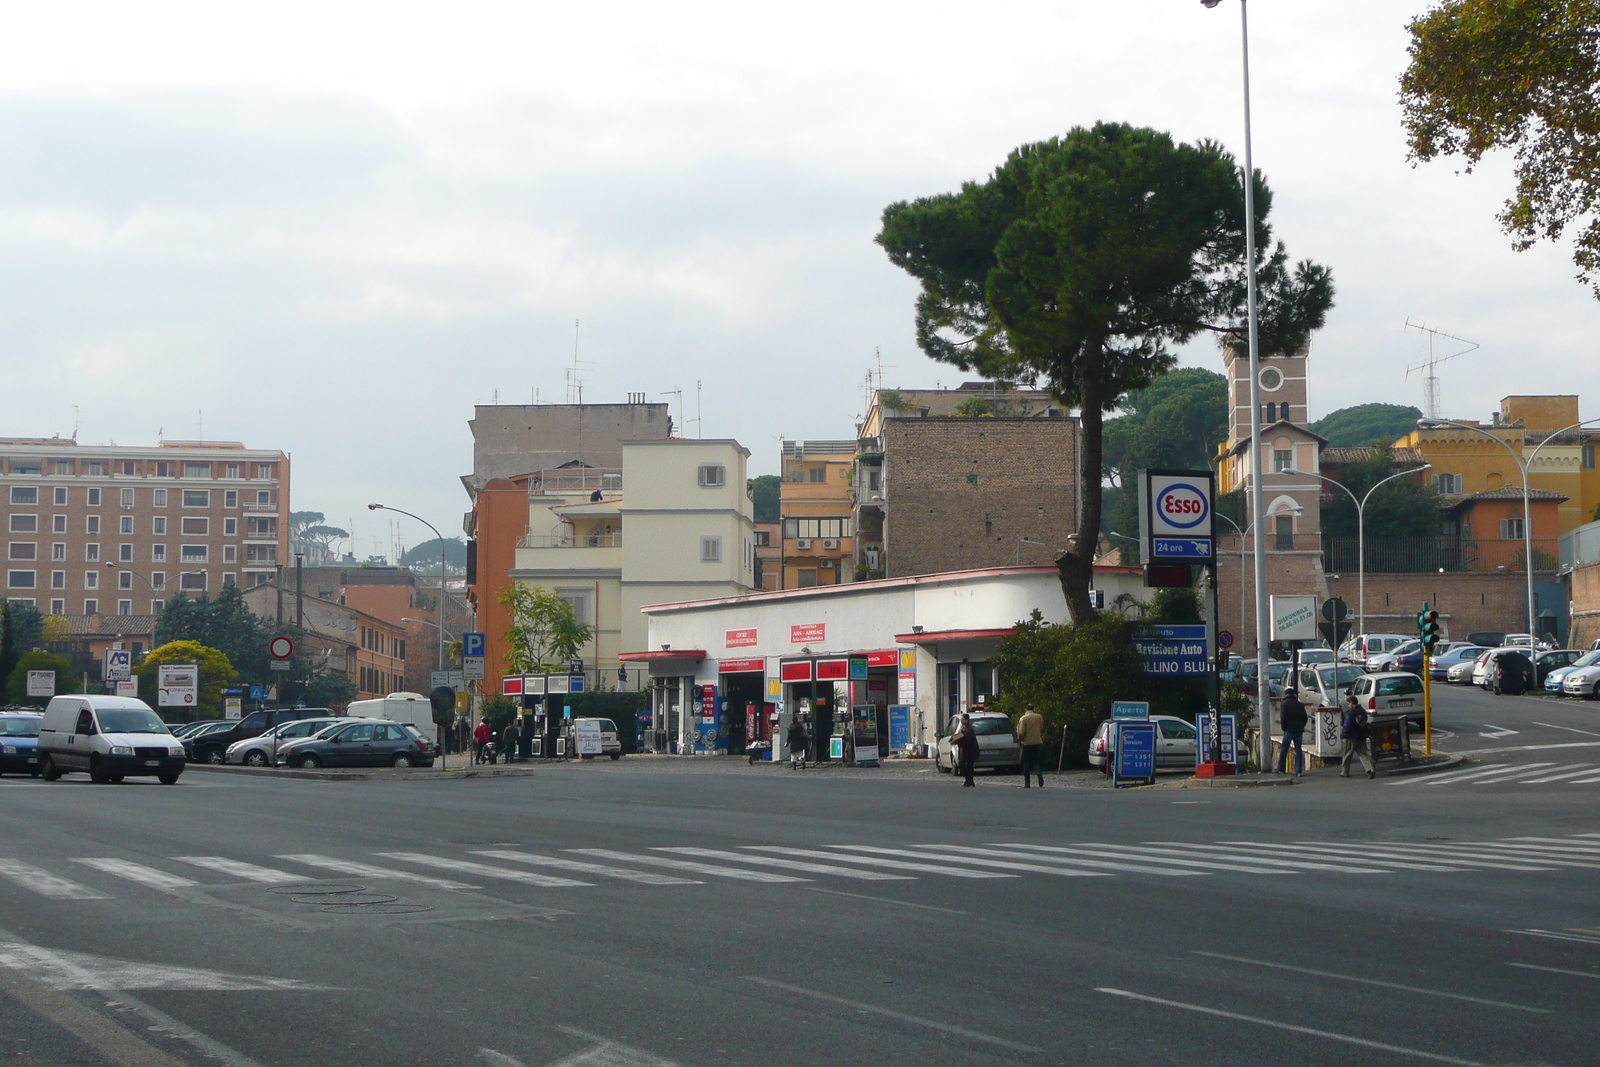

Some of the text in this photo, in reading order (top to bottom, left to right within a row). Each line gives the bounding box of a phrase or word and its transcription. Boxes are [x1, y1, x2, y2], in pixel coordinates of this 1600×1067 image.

[1165, 495, 1201, 514] Esso
[1157, 543, 1169, 552] 24
[1276, 606, 1309, 625] DISPONIBILE
[467, 635, 482, 655] P
[1136, 643, 1203, 655] Revisione Auto
[1142, 661, 1206, 673] LLINO BLU
[1115, 706, 1145, 714] Aperto
